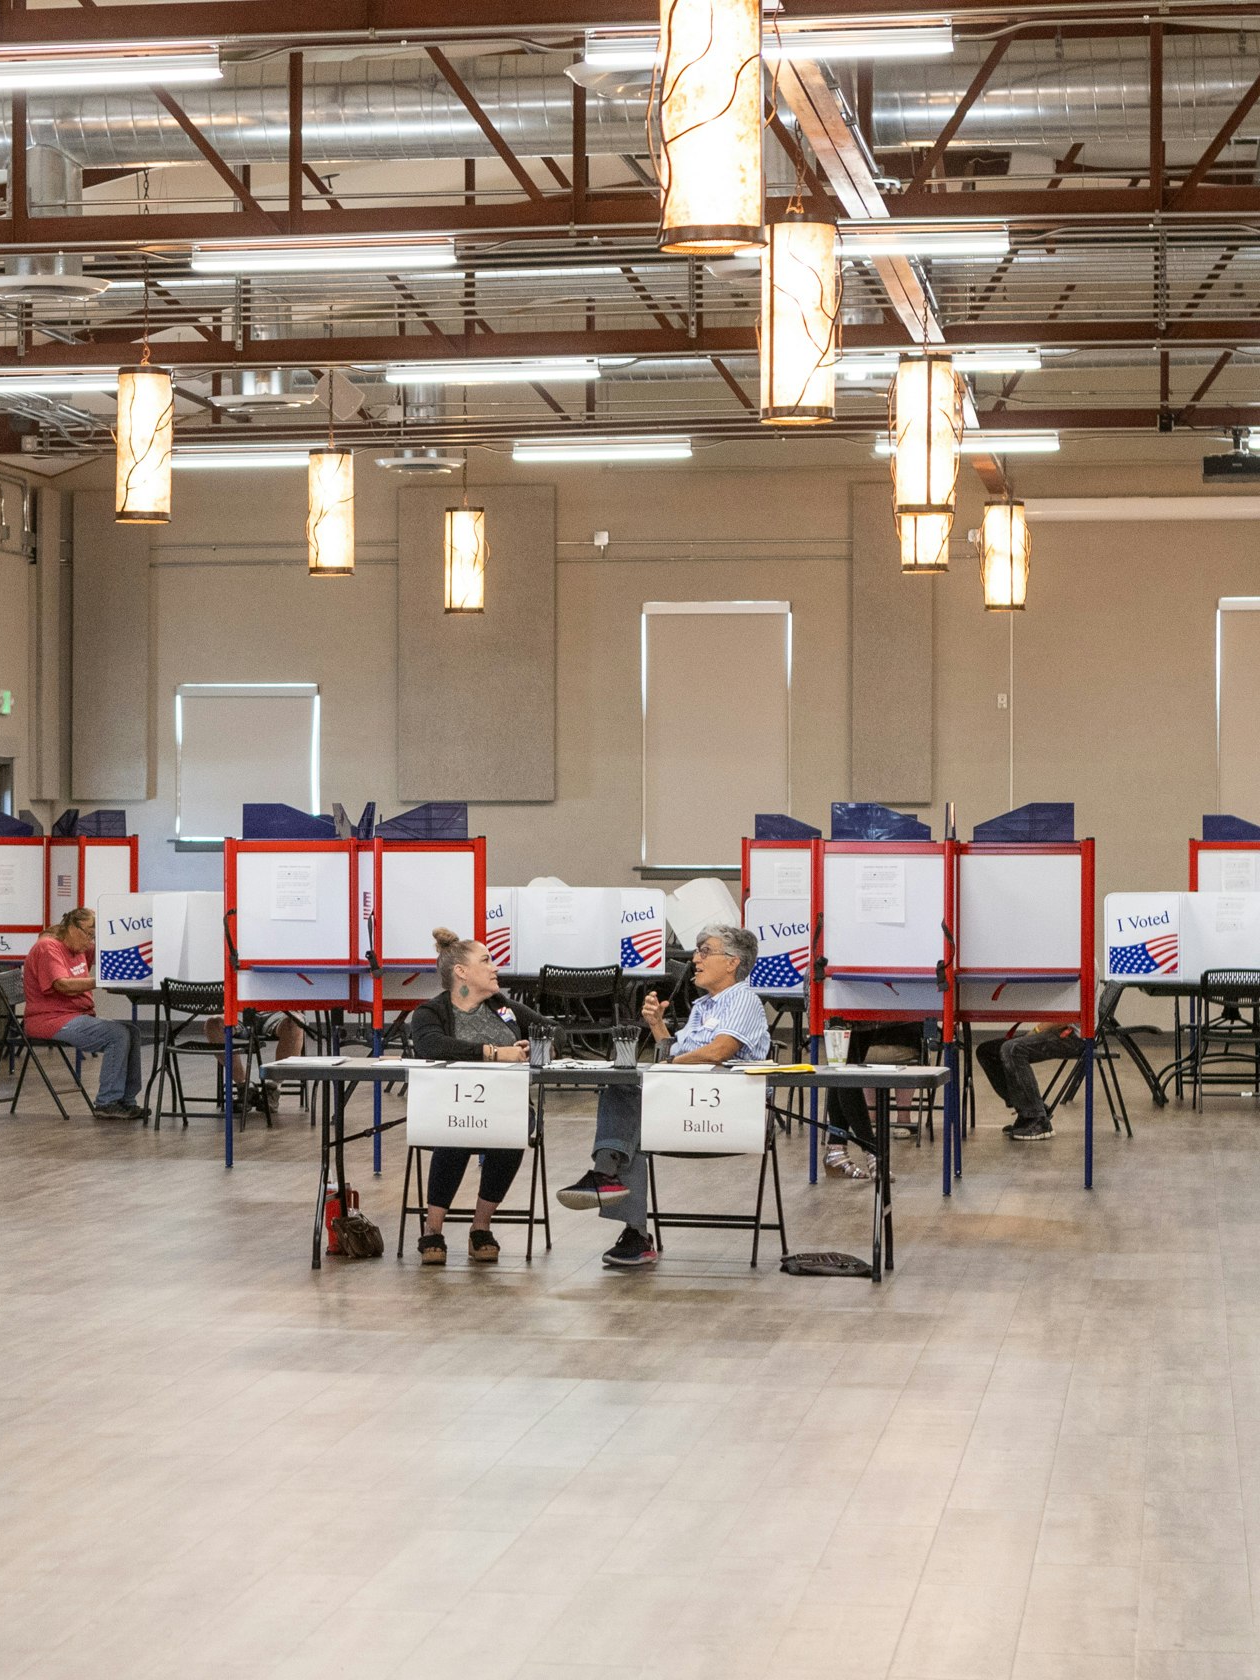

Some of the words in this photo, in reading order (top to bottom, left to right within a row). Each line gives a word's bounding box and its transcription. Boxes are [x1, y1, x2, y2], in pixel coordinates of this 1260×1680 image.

[108, 920, 116, 935] I
[119, 916, 153, 932] Vote
[1117, 918, 1124, 932] I
[1128, 910, 1170, 930] Voted
[758, 925, 766, 941] I
[453, 1083, 486, 1103] 1-2
[689, 1087, 721, 1108] 1-3
[448, 1115, 488, 1129] Ballot
[683, 1119, 724, 1133] Ballot
